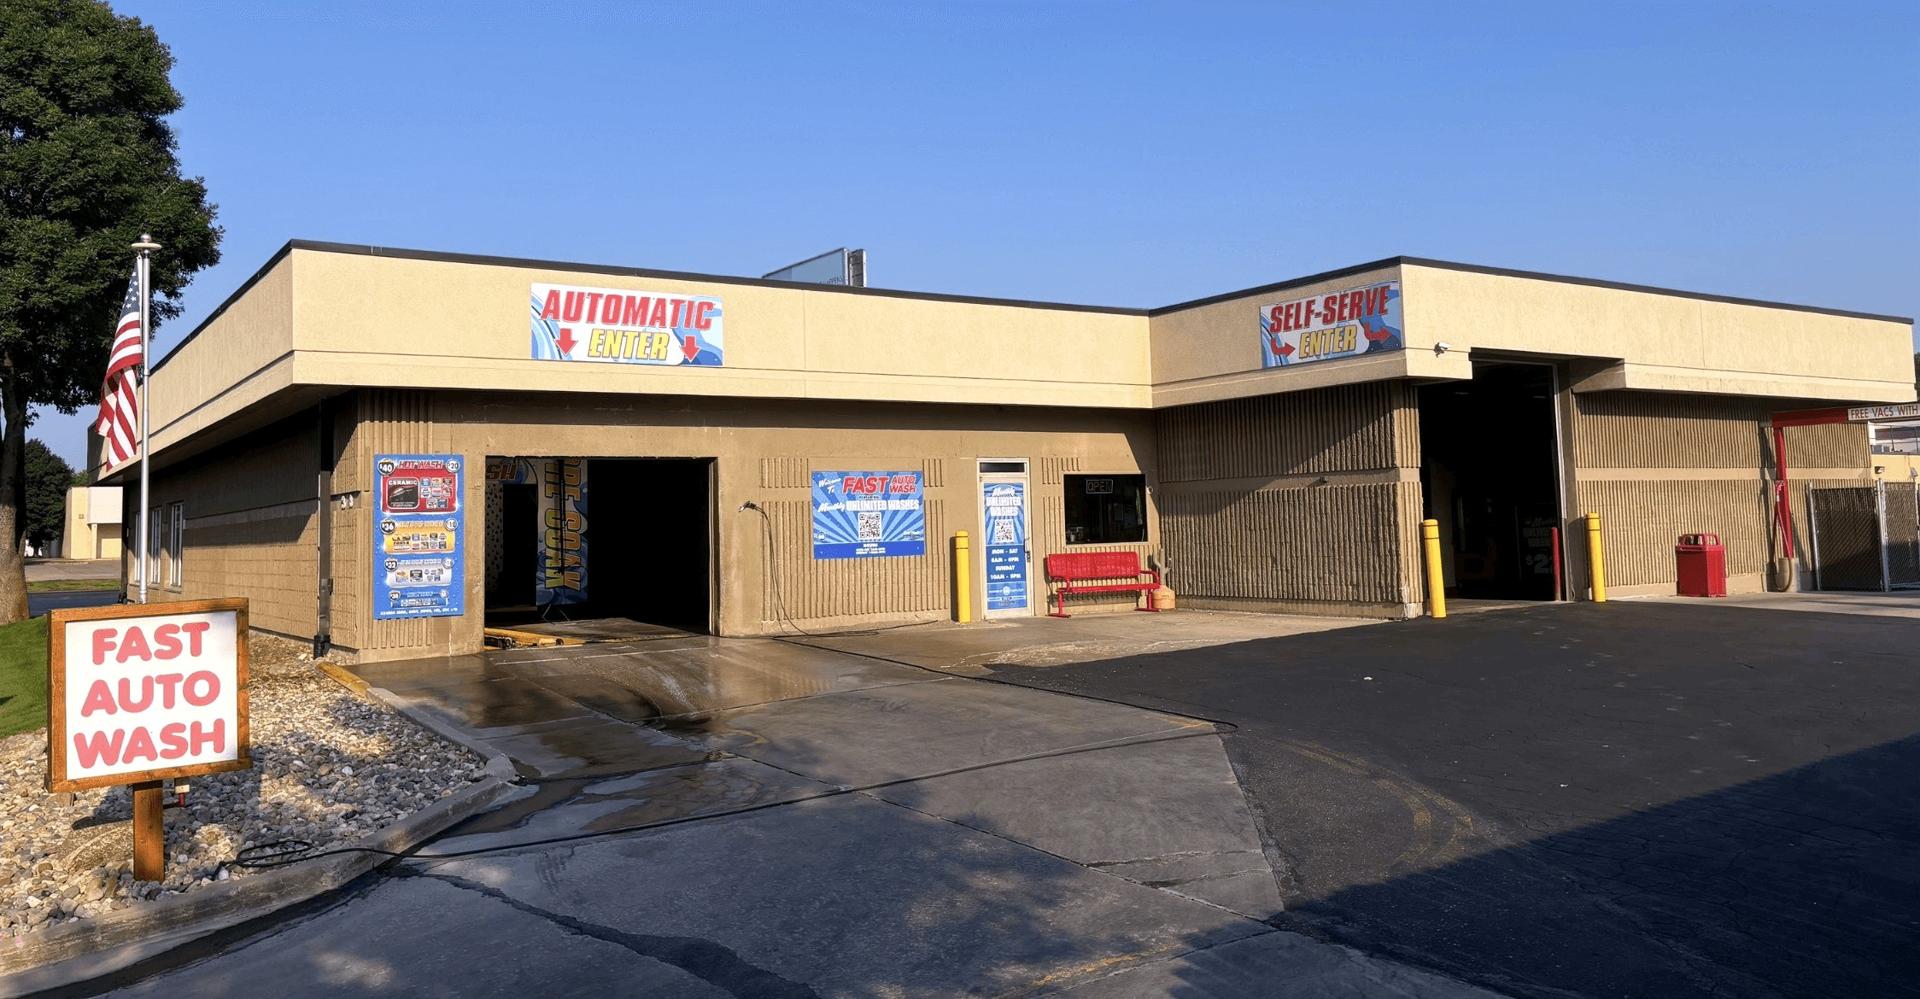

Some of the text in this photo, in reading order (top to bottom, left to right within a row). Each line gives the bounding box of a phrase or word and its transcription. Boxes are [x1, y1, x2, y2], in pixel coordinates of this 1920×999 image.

[540, 289, 716, 331] AUTOMATIC
[1270, 285, 1391, 333] SELF-SERVE
[587, 328, 671, 361] ENTER
[1299, 325, 1358, 359] ENTER
[1850, 404, 1919, 418] FREE VACS WITH
[379, 463, 393, 472] $40
[891, 475, 916, 484] AUTO
[842, 475, 891, 495] FAST
[889, 484, 916, 494] WASH
[818, 499, 920, 512] Monthly UNLIMITED WASHES
[92, 621, 210, 665] FAST
[80, 670, 221, 718] AUTO
[73, 718, 226, 769] WASH
